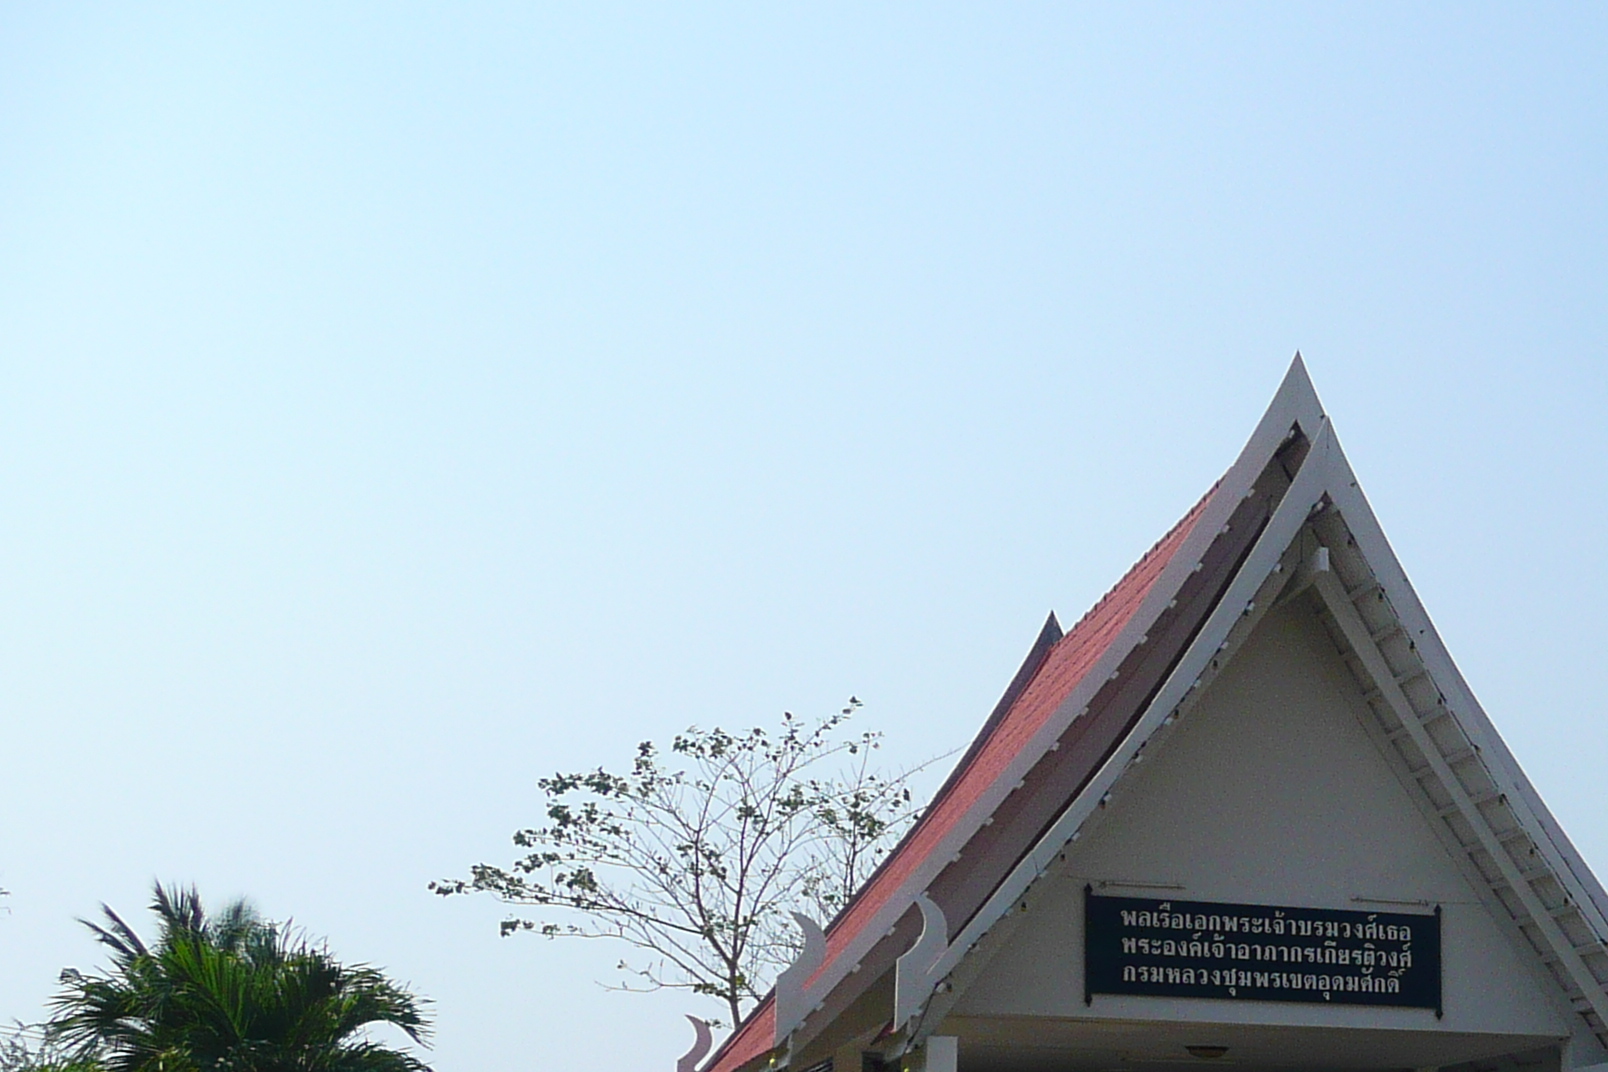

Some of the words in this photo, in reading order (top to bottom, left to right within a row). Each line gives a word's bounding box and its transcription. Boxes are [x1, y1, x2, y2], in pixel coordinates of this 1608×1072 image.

[1120, 902, 1412, 941] พลเรือเอกพระเจ้าบรมวงศ์เธอ
[1121, 931, 1412, 968] พระองค์เจ้าอาภากรเกียรติวงศ์
[1122, 965, 1406, 1000] กรมหลวงชุมพรเขตอุดมศักดิ์
